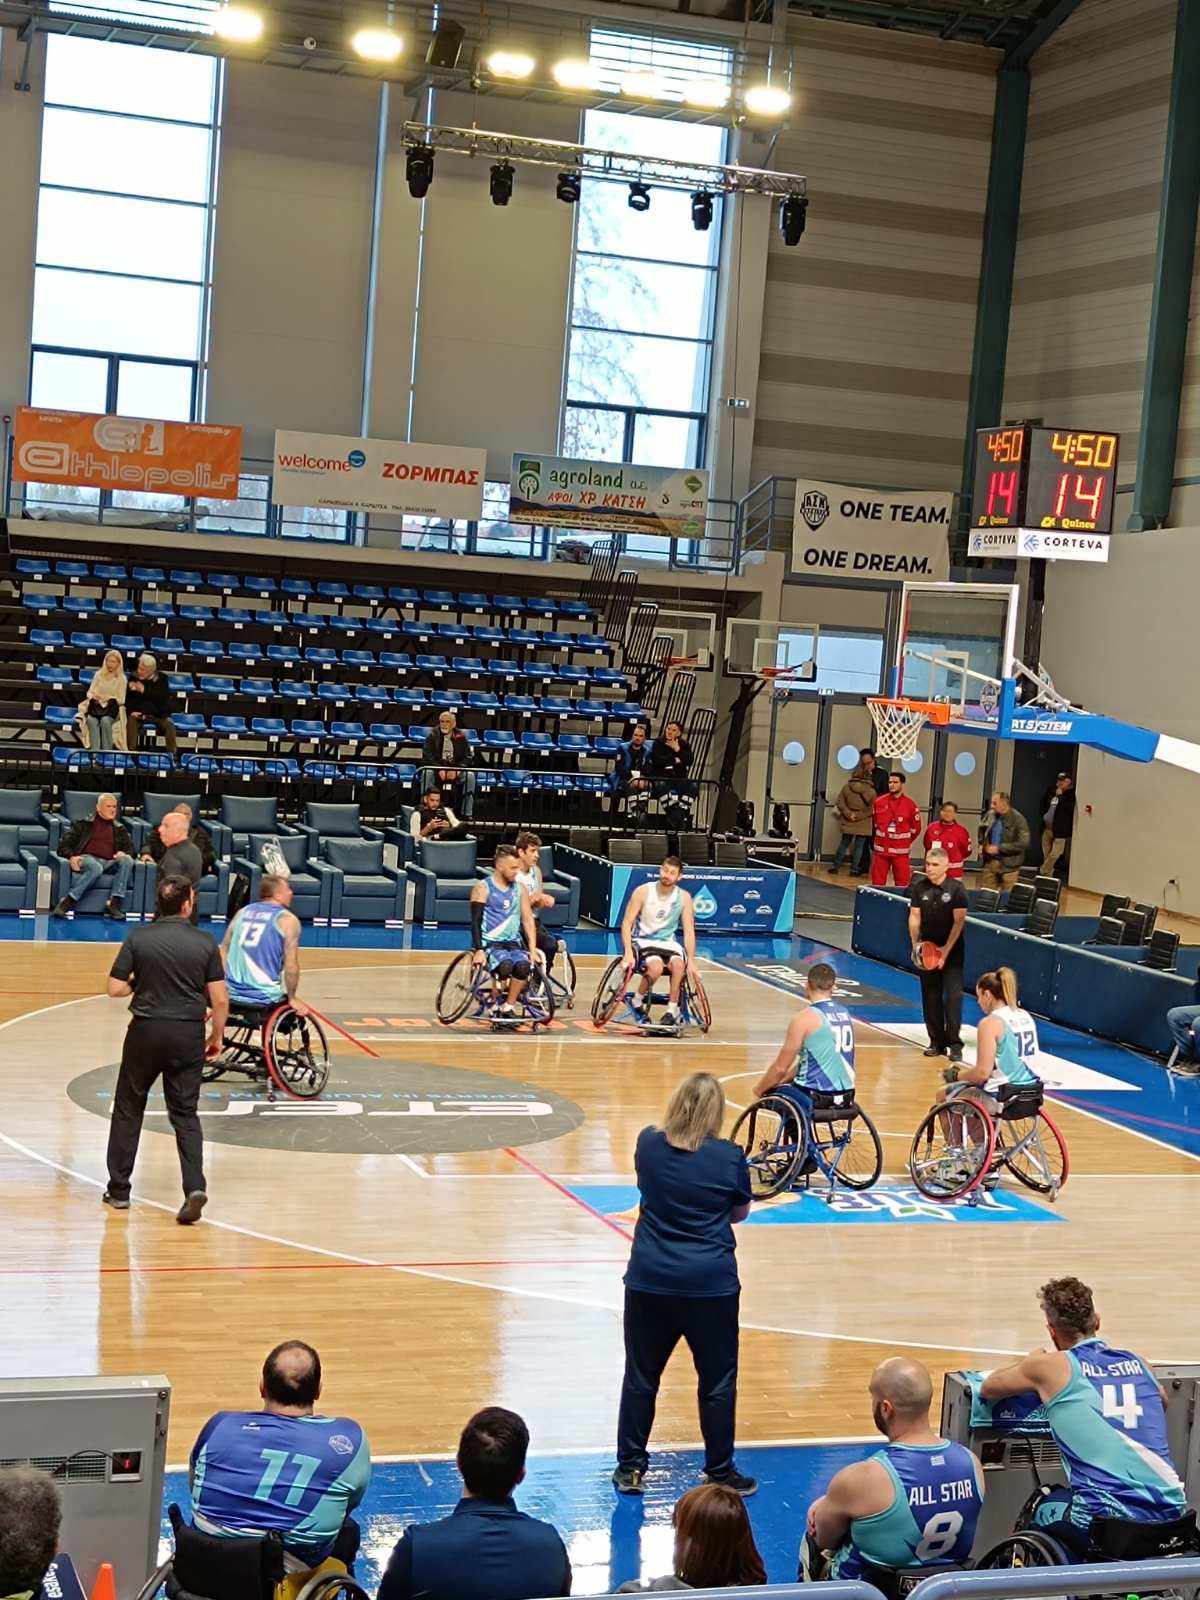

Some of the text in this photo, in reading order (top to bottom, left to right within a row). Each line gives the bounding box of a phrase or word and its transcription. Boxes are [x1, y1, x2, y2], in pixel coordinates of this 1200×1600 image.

[987, 430, 1024, 462] 4:50
[1052, 432, 1117, 468] 4:50
[278, 453, 352, 473] welcome
[382, 462, 480, 486] ΖΟΡΜΠΑΣ
[549, 466, 623, 489] agroland
[988, 471, 1017, 516] 14
[1055, 473, 1105, 519] 14
[840, 500, 950, 524] ONE TEAM.
[983, 535, 1017, 545] CORTEVA
[1044, 537, 1104, 549] CORTEVA
[804, 548, 933, 574] ONE DREAM.
[239, 922, 267, 948] 13
[831, 1025, 853, 1053] 10
[1014, 1031, 1035, 1057] 12
[1081, 1359, 1144, 1377] ALL STAR
[1102, 1383, 1144, 1429] 4
[254, 1448, 322, 1506] 11
[909, 1479, 973, 1506] ALL STAR
[915, 1510, 964, 1561] 8
